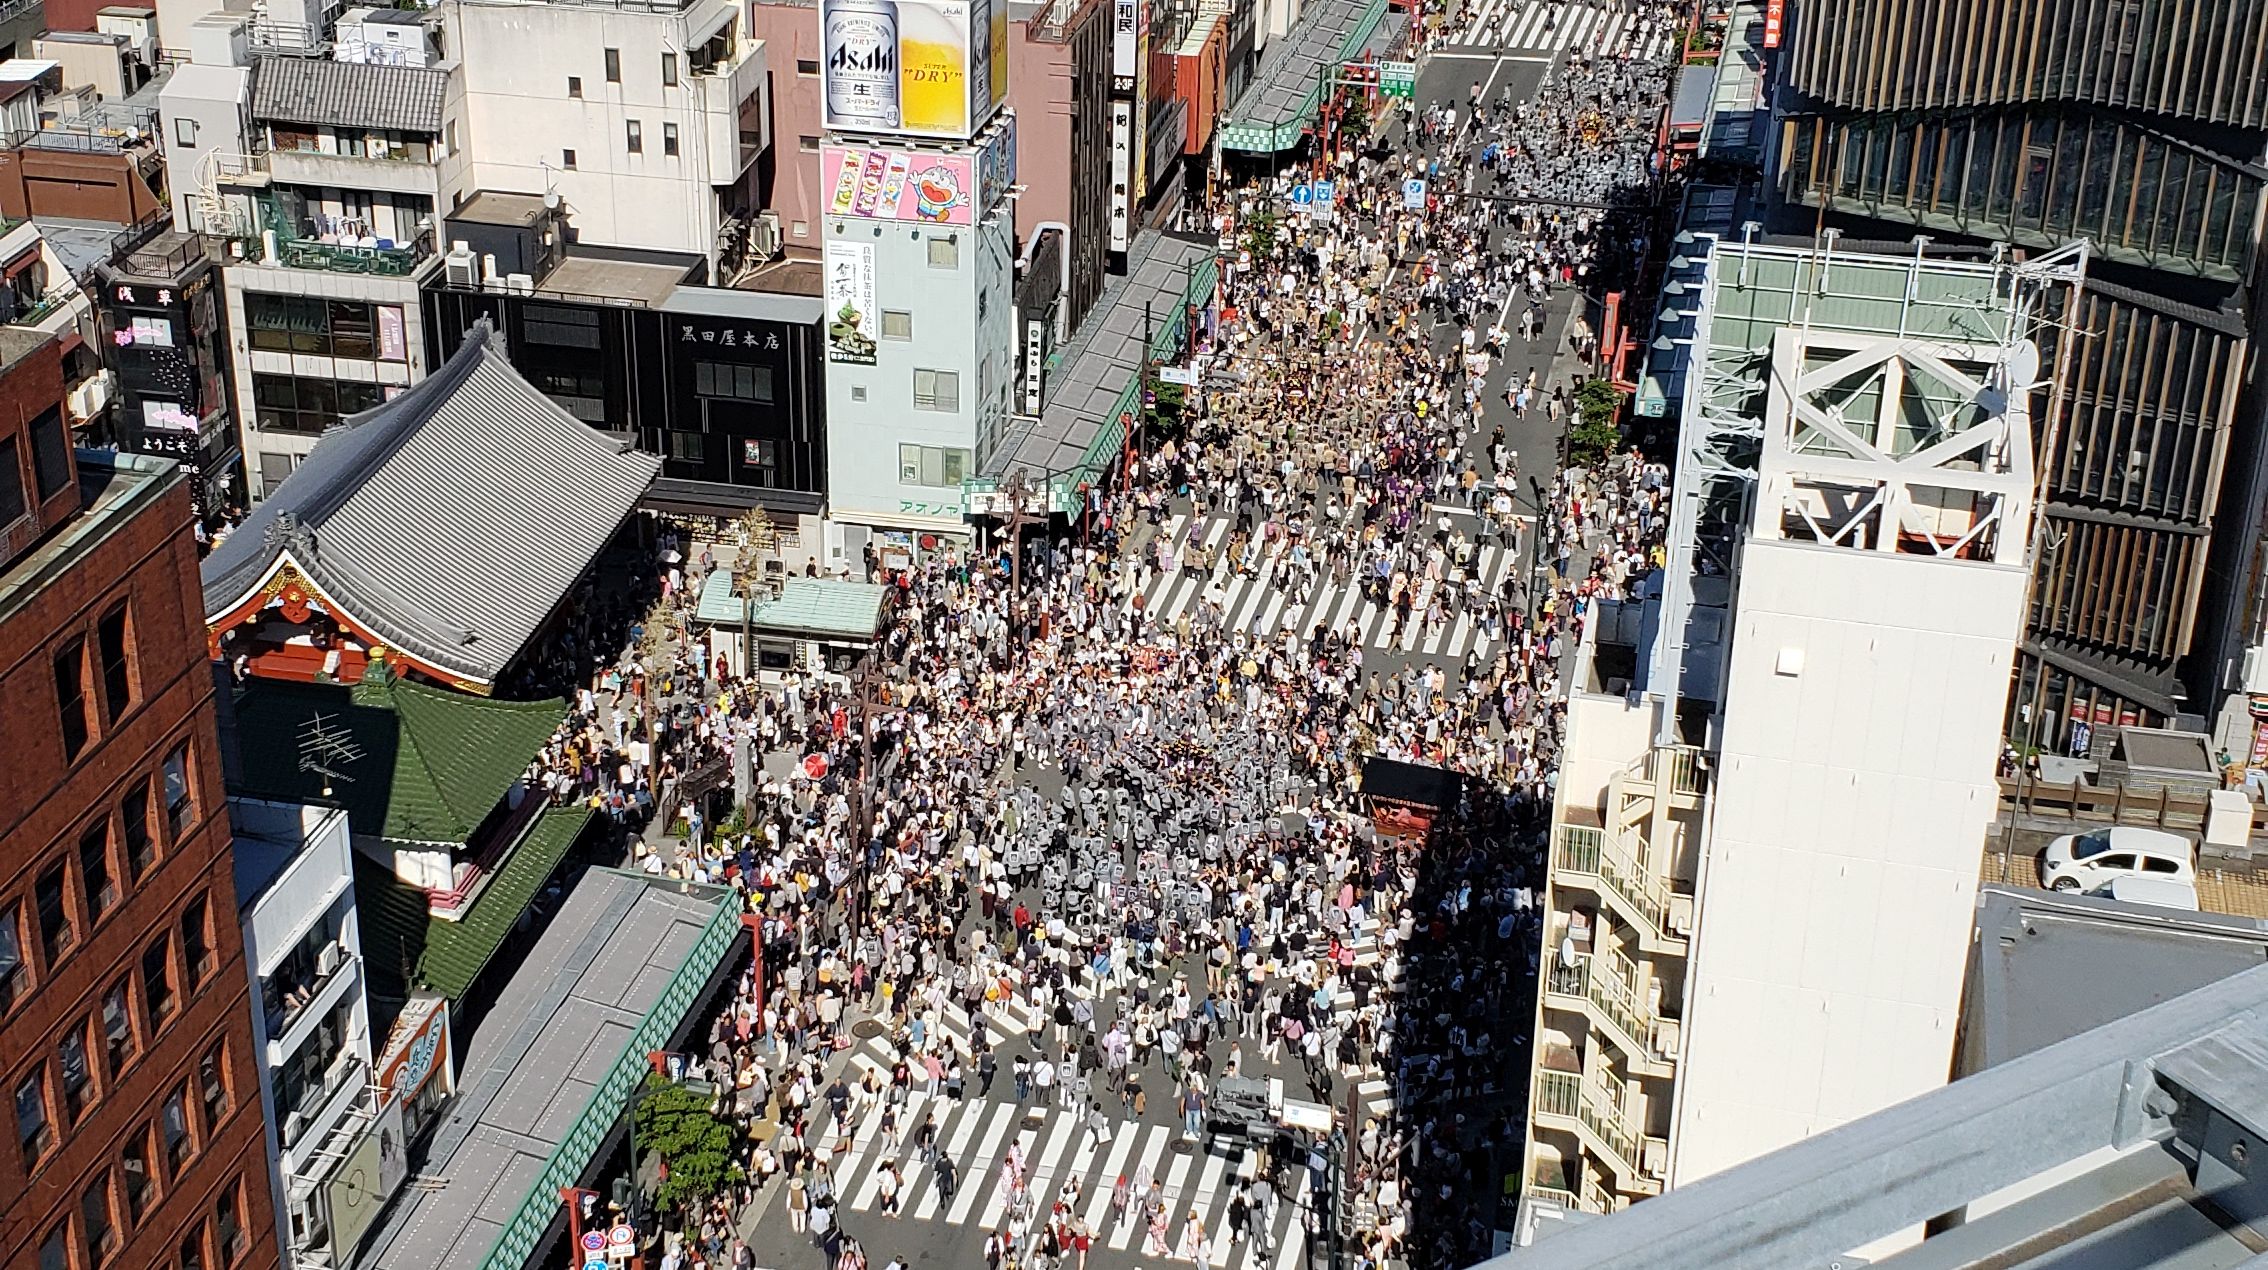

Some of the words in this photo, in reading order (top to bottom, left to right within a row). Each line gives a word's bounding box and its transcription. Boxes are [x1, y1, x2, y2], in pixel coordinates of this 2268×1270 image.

[1118, 4, 1133, 32] 和民
[830, 41, 893, 74] Asahi
[853, 83, 871, 97] 生
[118, 286, 174, 307] 浅草
[681, 325, 780, 350] 黒田屋本店
[142, 436, 188, 454] ようこそ
[899, 501, 960, 516] アオノヤ
